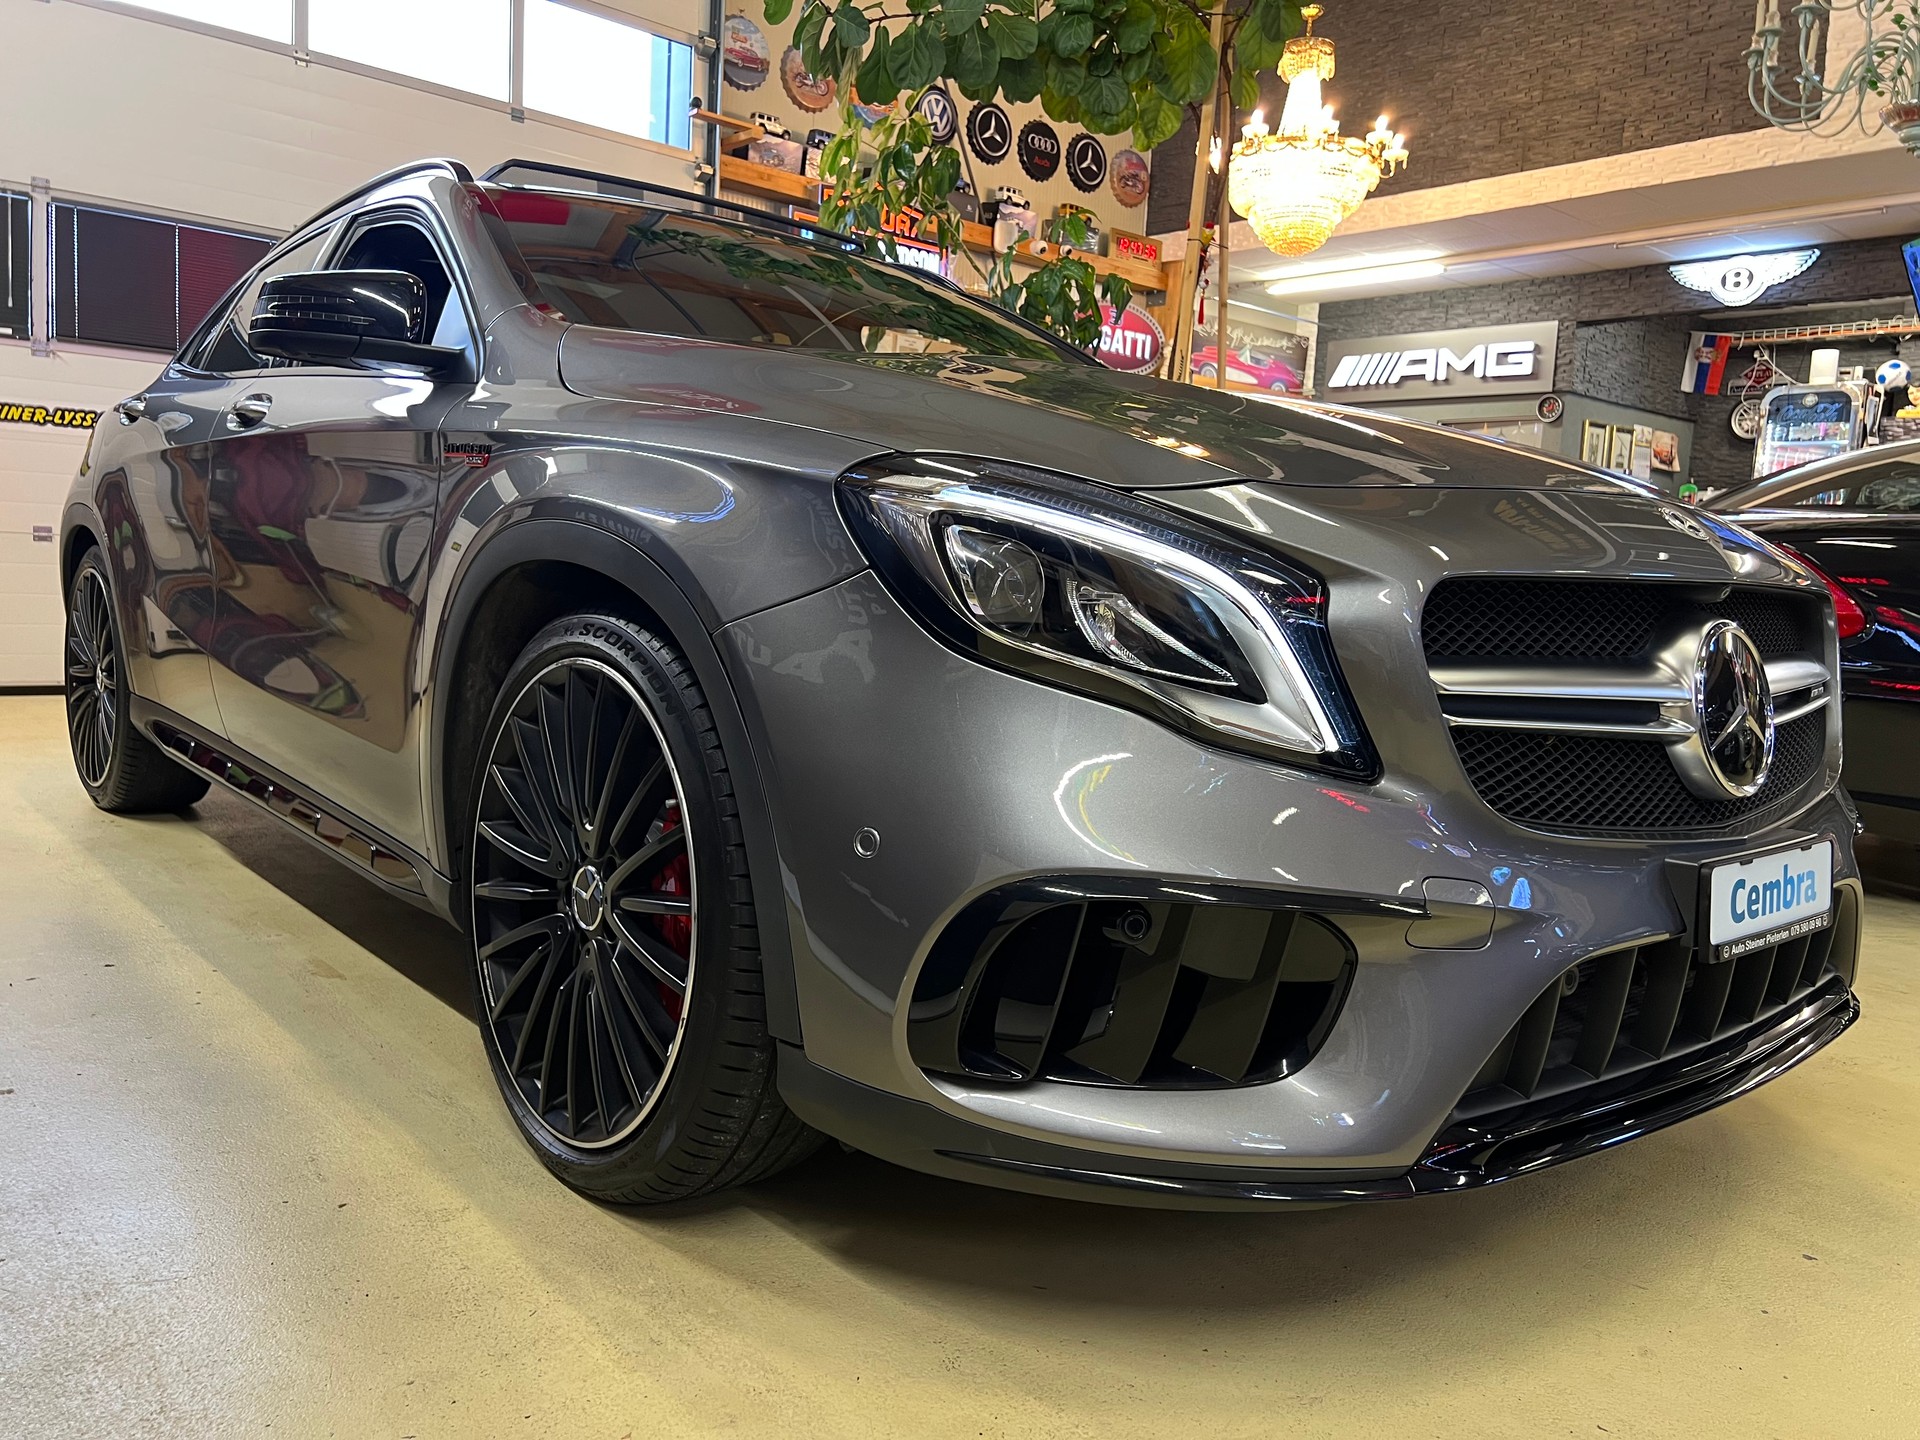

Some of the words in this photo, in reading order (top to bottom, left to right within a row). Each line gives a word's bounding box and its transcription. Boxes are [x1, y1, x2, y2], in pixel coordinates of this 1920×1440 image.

[1033, 155, 1051, 169] Audi
[1098, 323, 1152, 361] GATTI
[1387, 340, 1536, 382] AMG
[0, 403, 97, 427] INER-LYSS.
[578, 622, 680, 716] SCORPION
[1730, 863, 1817, 924] Cembra
[1731, 944, 1745, 955] Auto
[1745, 937, 1766, 951] Steiner
[1766, 930, 1790, 945] Pieterlen
[1790, 925, 1800, 936] 079
